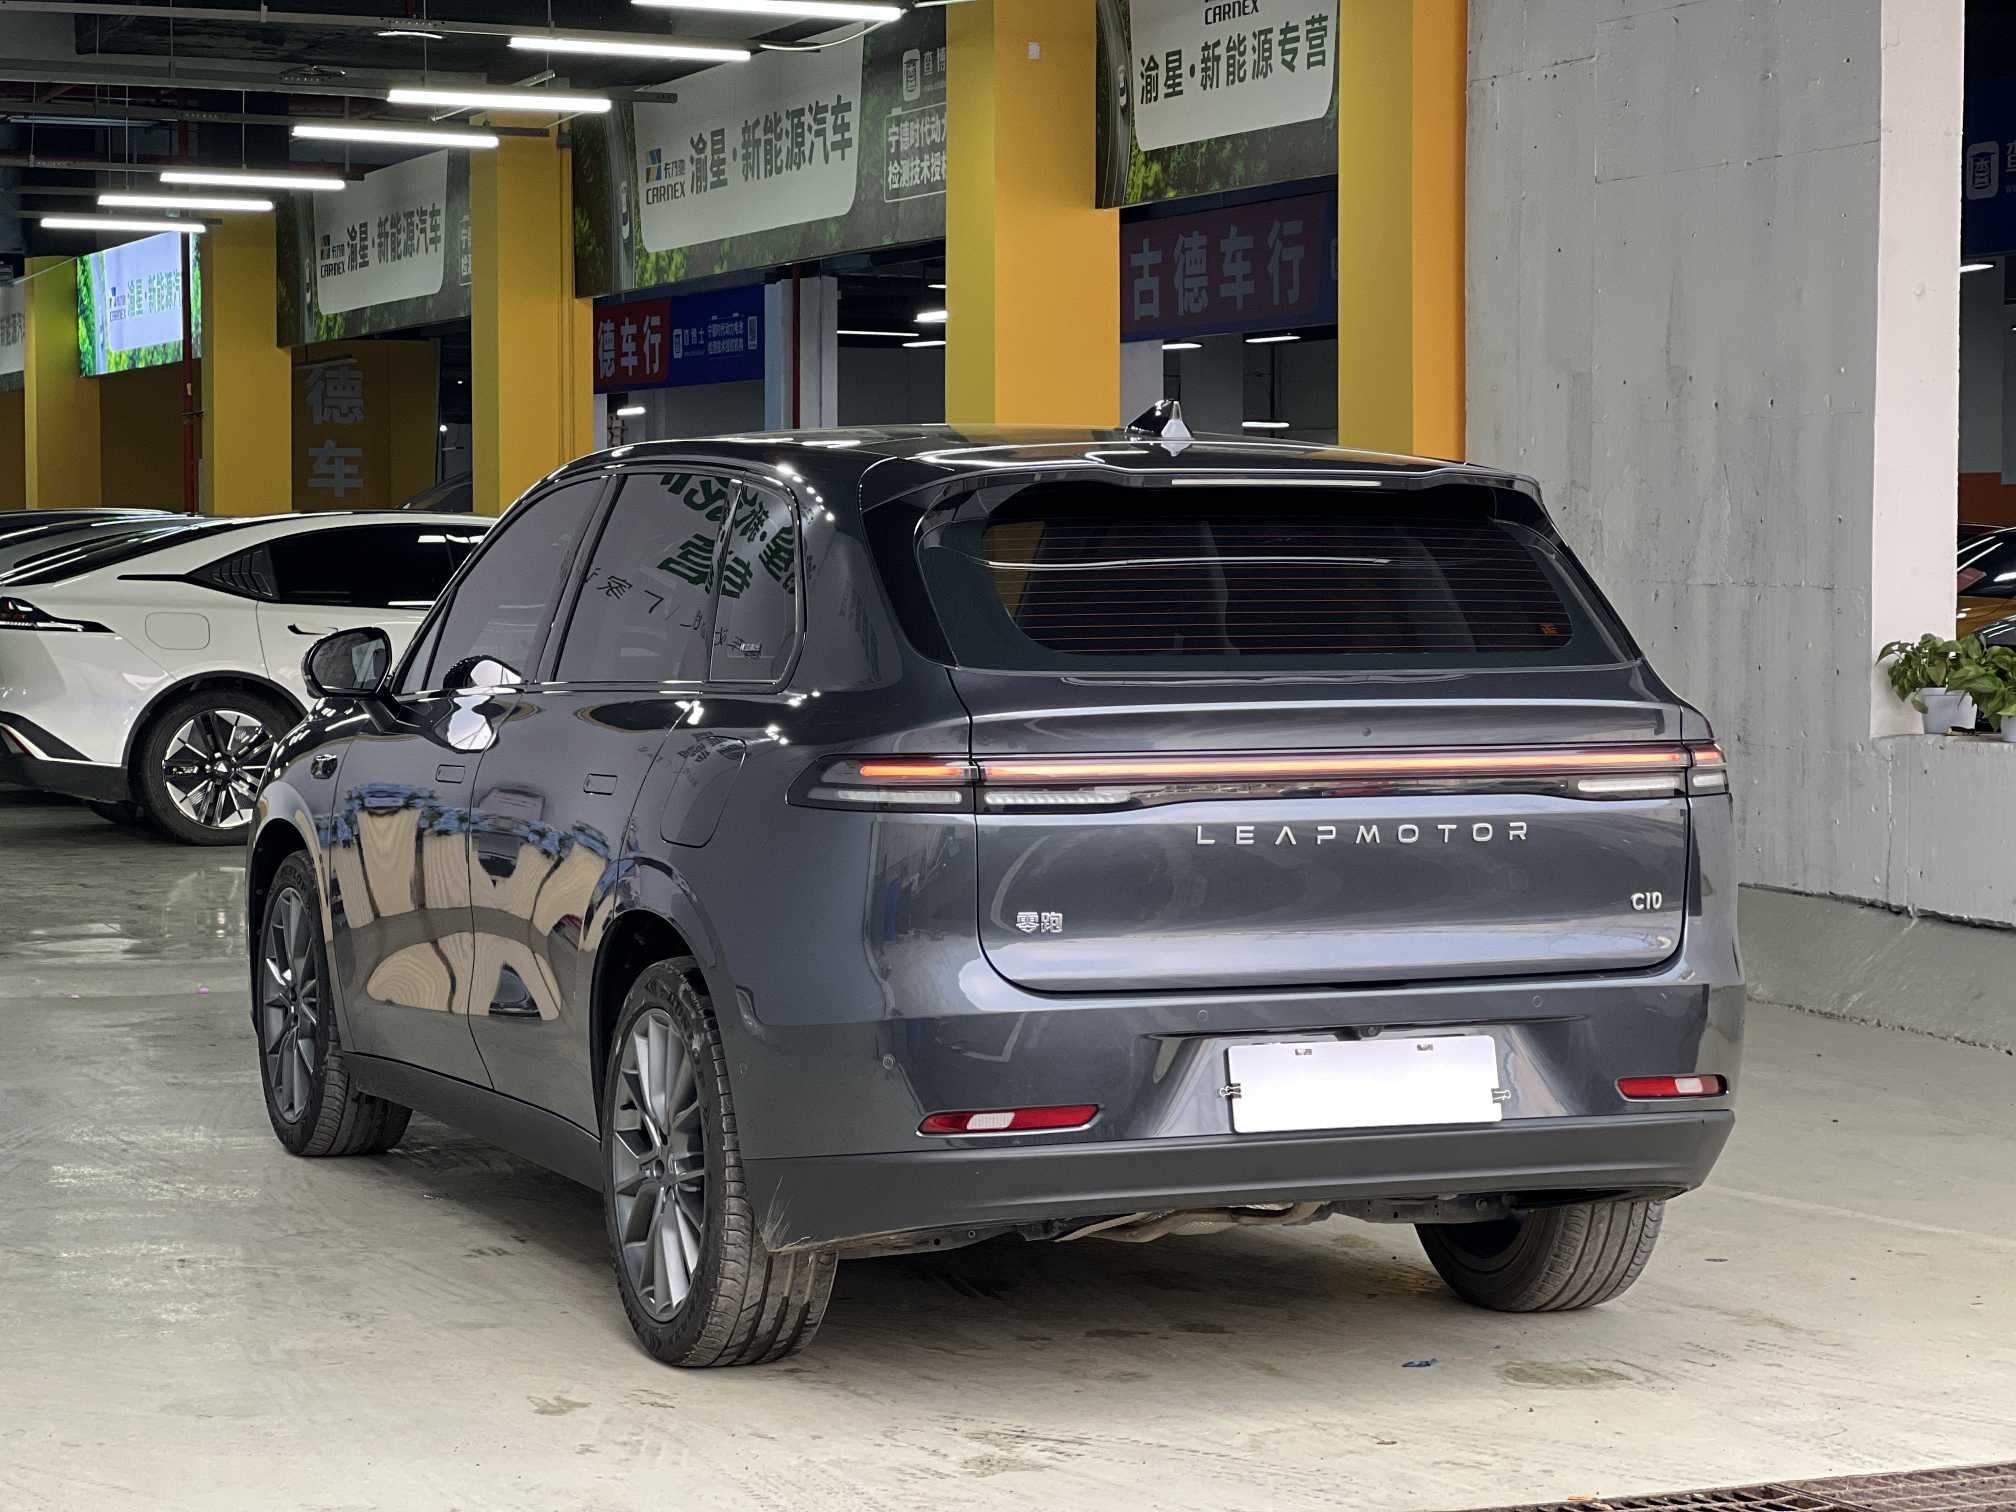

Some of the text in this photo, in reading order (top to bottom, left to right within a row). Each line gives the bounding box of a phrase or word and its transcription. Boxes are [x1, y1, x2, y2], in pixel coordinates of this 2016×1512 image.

[1204, 0, 1260, 25] CARNEX
[1140, 13, 1329, 105] 渝星·新能源专营
[689, 94, 853, 195] 渝星·新能源汽车
[645, 181, 686, 206] CARNEX
[1130, 219, 1305, 321] 古德车行
[597, 314, 663, 380] 德车行
[1196, 821, 1528, 847] LEAPMOTOR
[1631, 891, 1663, 911] C10
[1015, 911, 1064, 933] 零跑
